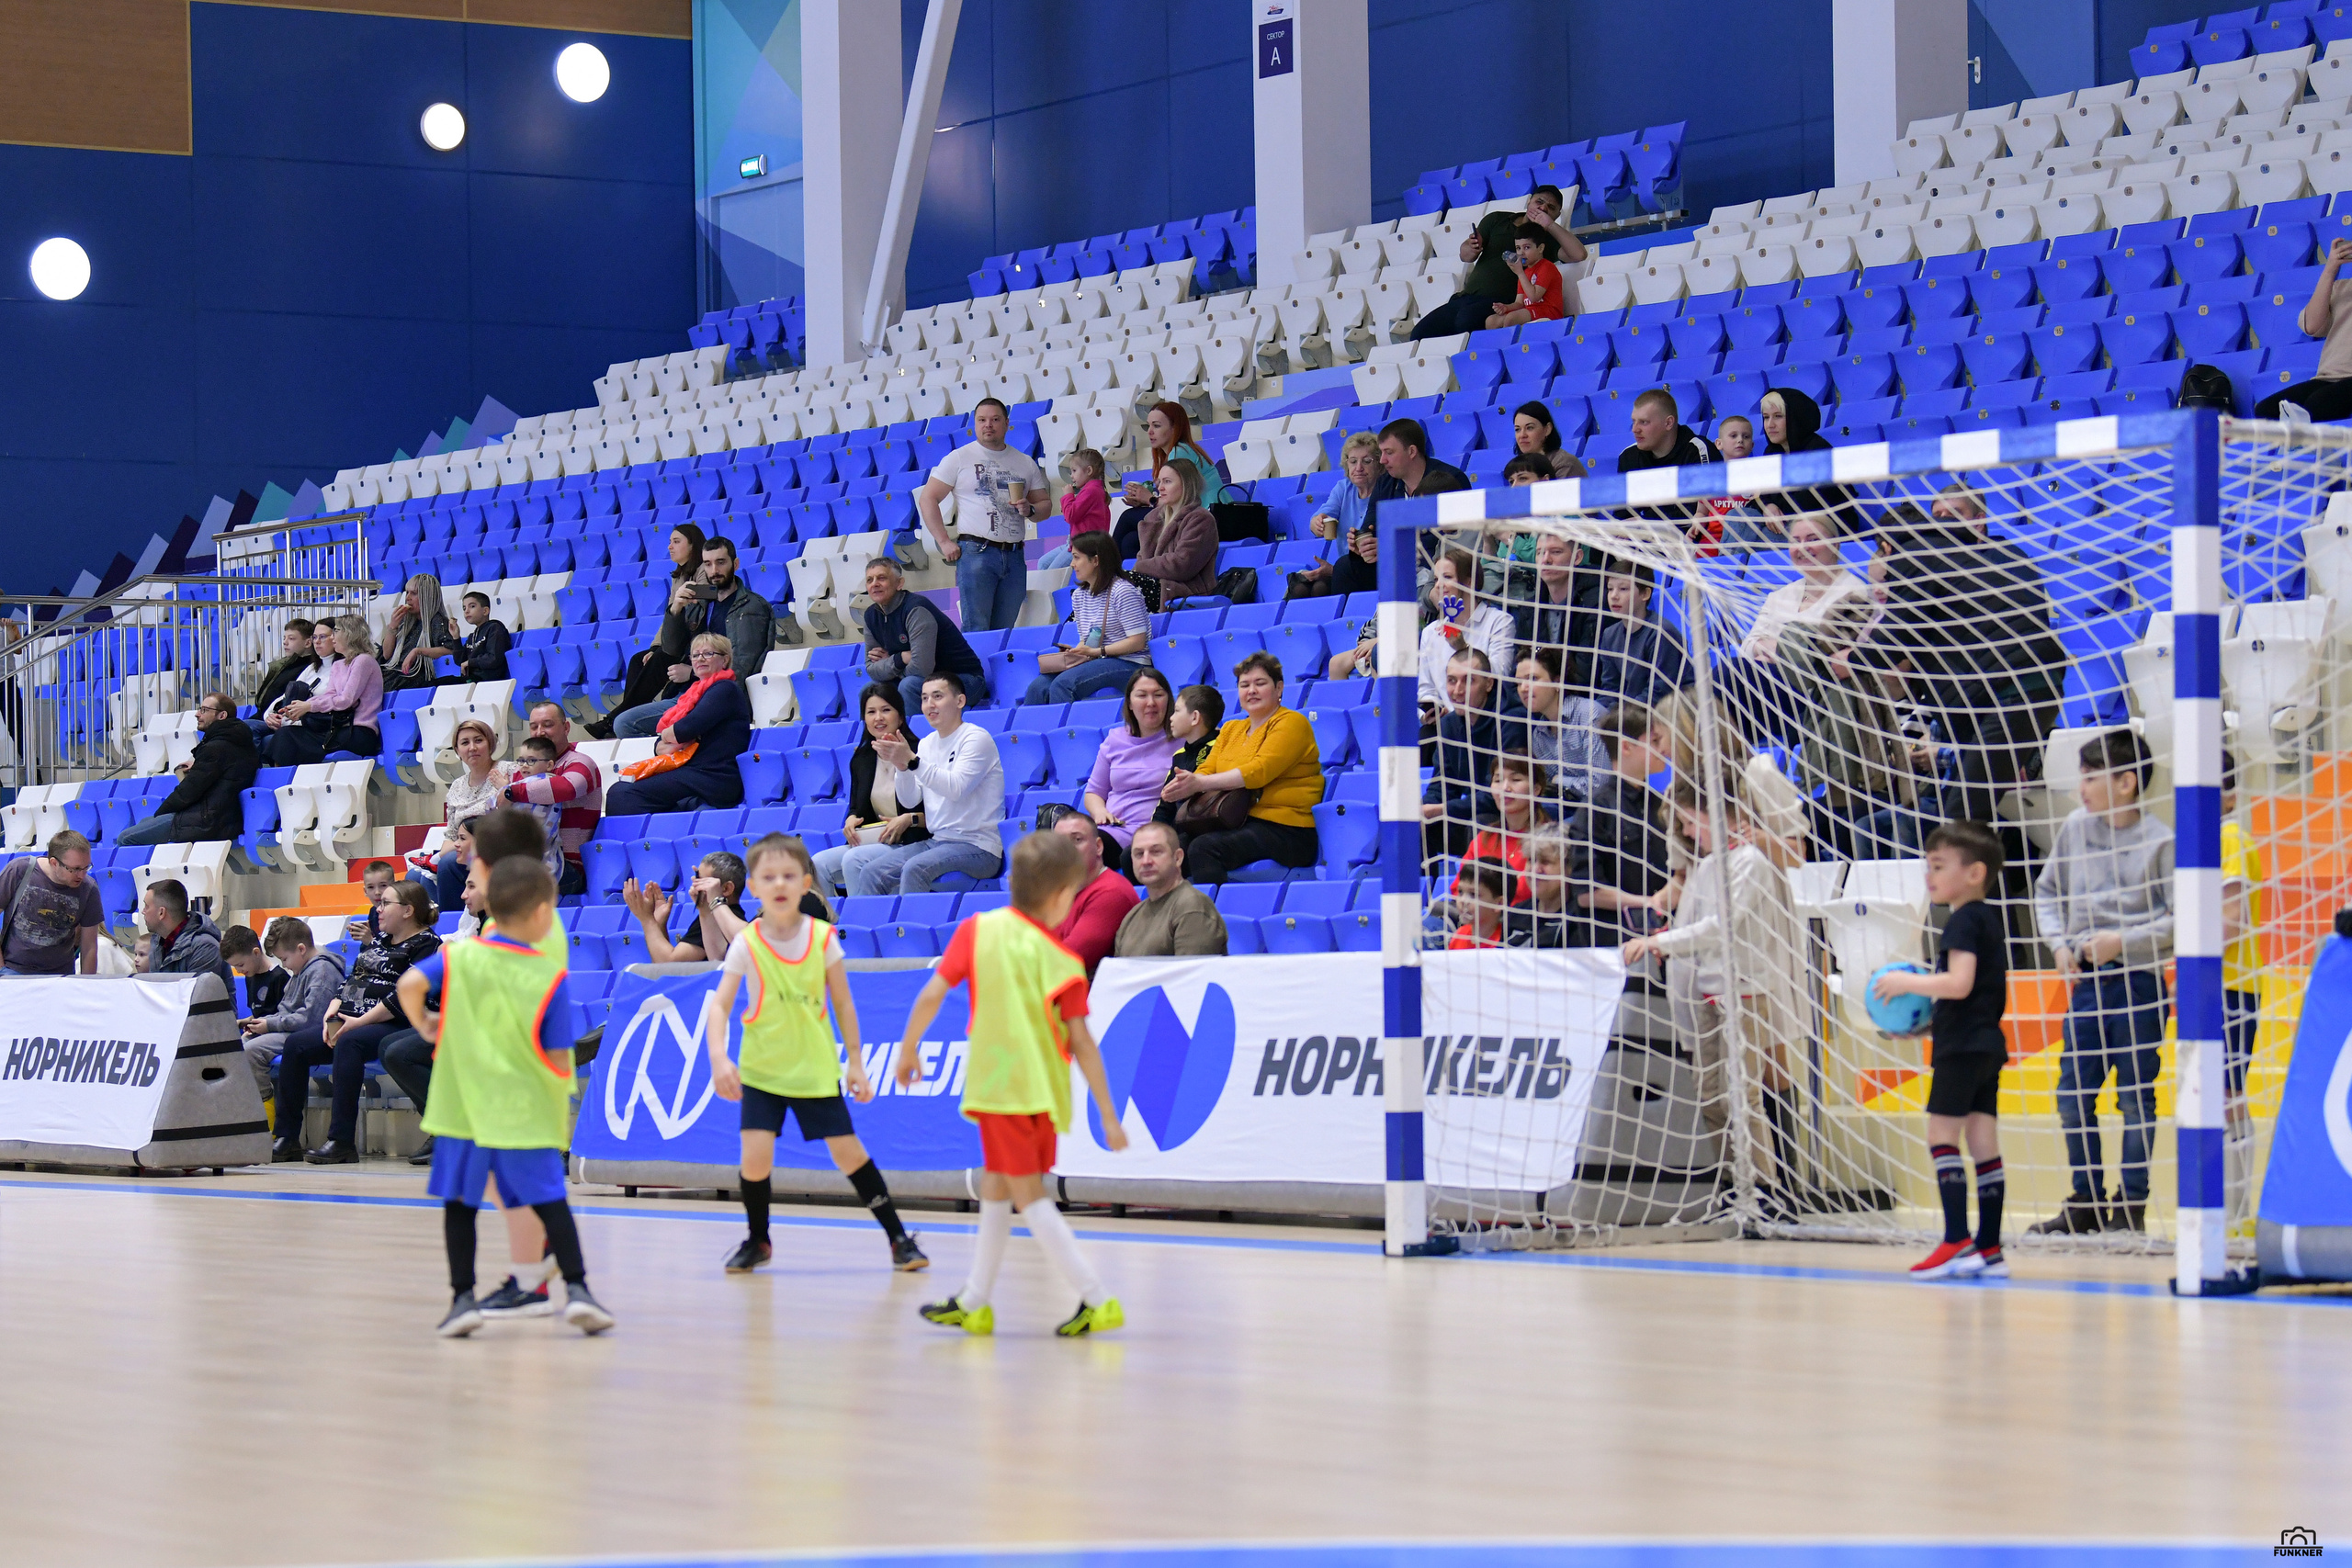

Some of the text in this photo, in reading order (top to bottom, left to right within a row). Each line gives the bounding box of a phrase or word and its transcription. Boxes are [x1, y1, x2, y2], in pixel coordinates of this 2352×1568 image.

[1267, 30, 1284, 40] СЕКТОР
[1271, 47, 1281, 66] А
[3, 1037, 160, 1087] НОРНИКЕЛЬ
